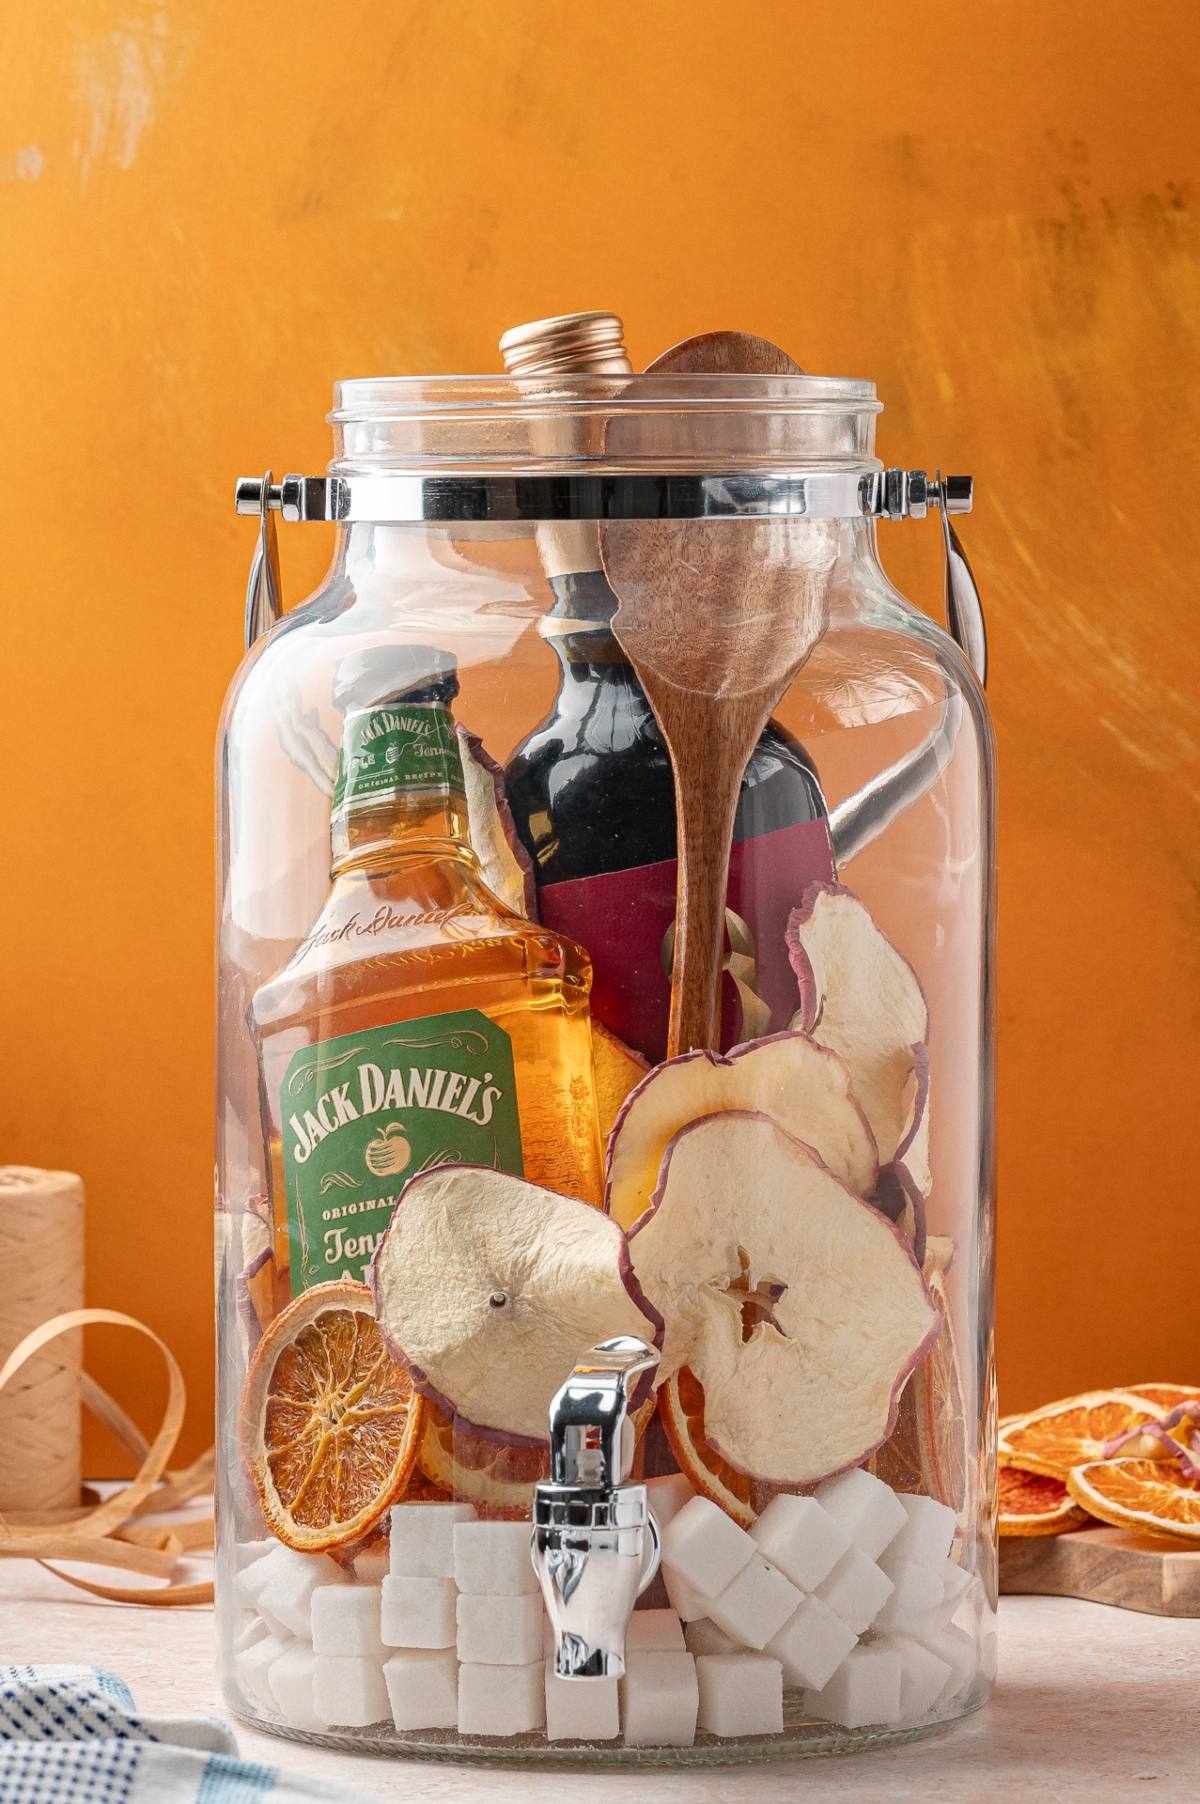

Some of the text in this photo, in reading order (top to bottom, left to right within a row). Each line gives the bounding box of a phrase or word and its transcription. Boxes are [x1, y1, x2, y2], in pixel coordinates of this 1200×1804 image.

[361, 718, 385, 746] JACK
[288, 1062, 503, 1164] JACK DANIEL'S
[322, 1195, 398, 1221] ORIGINAL
